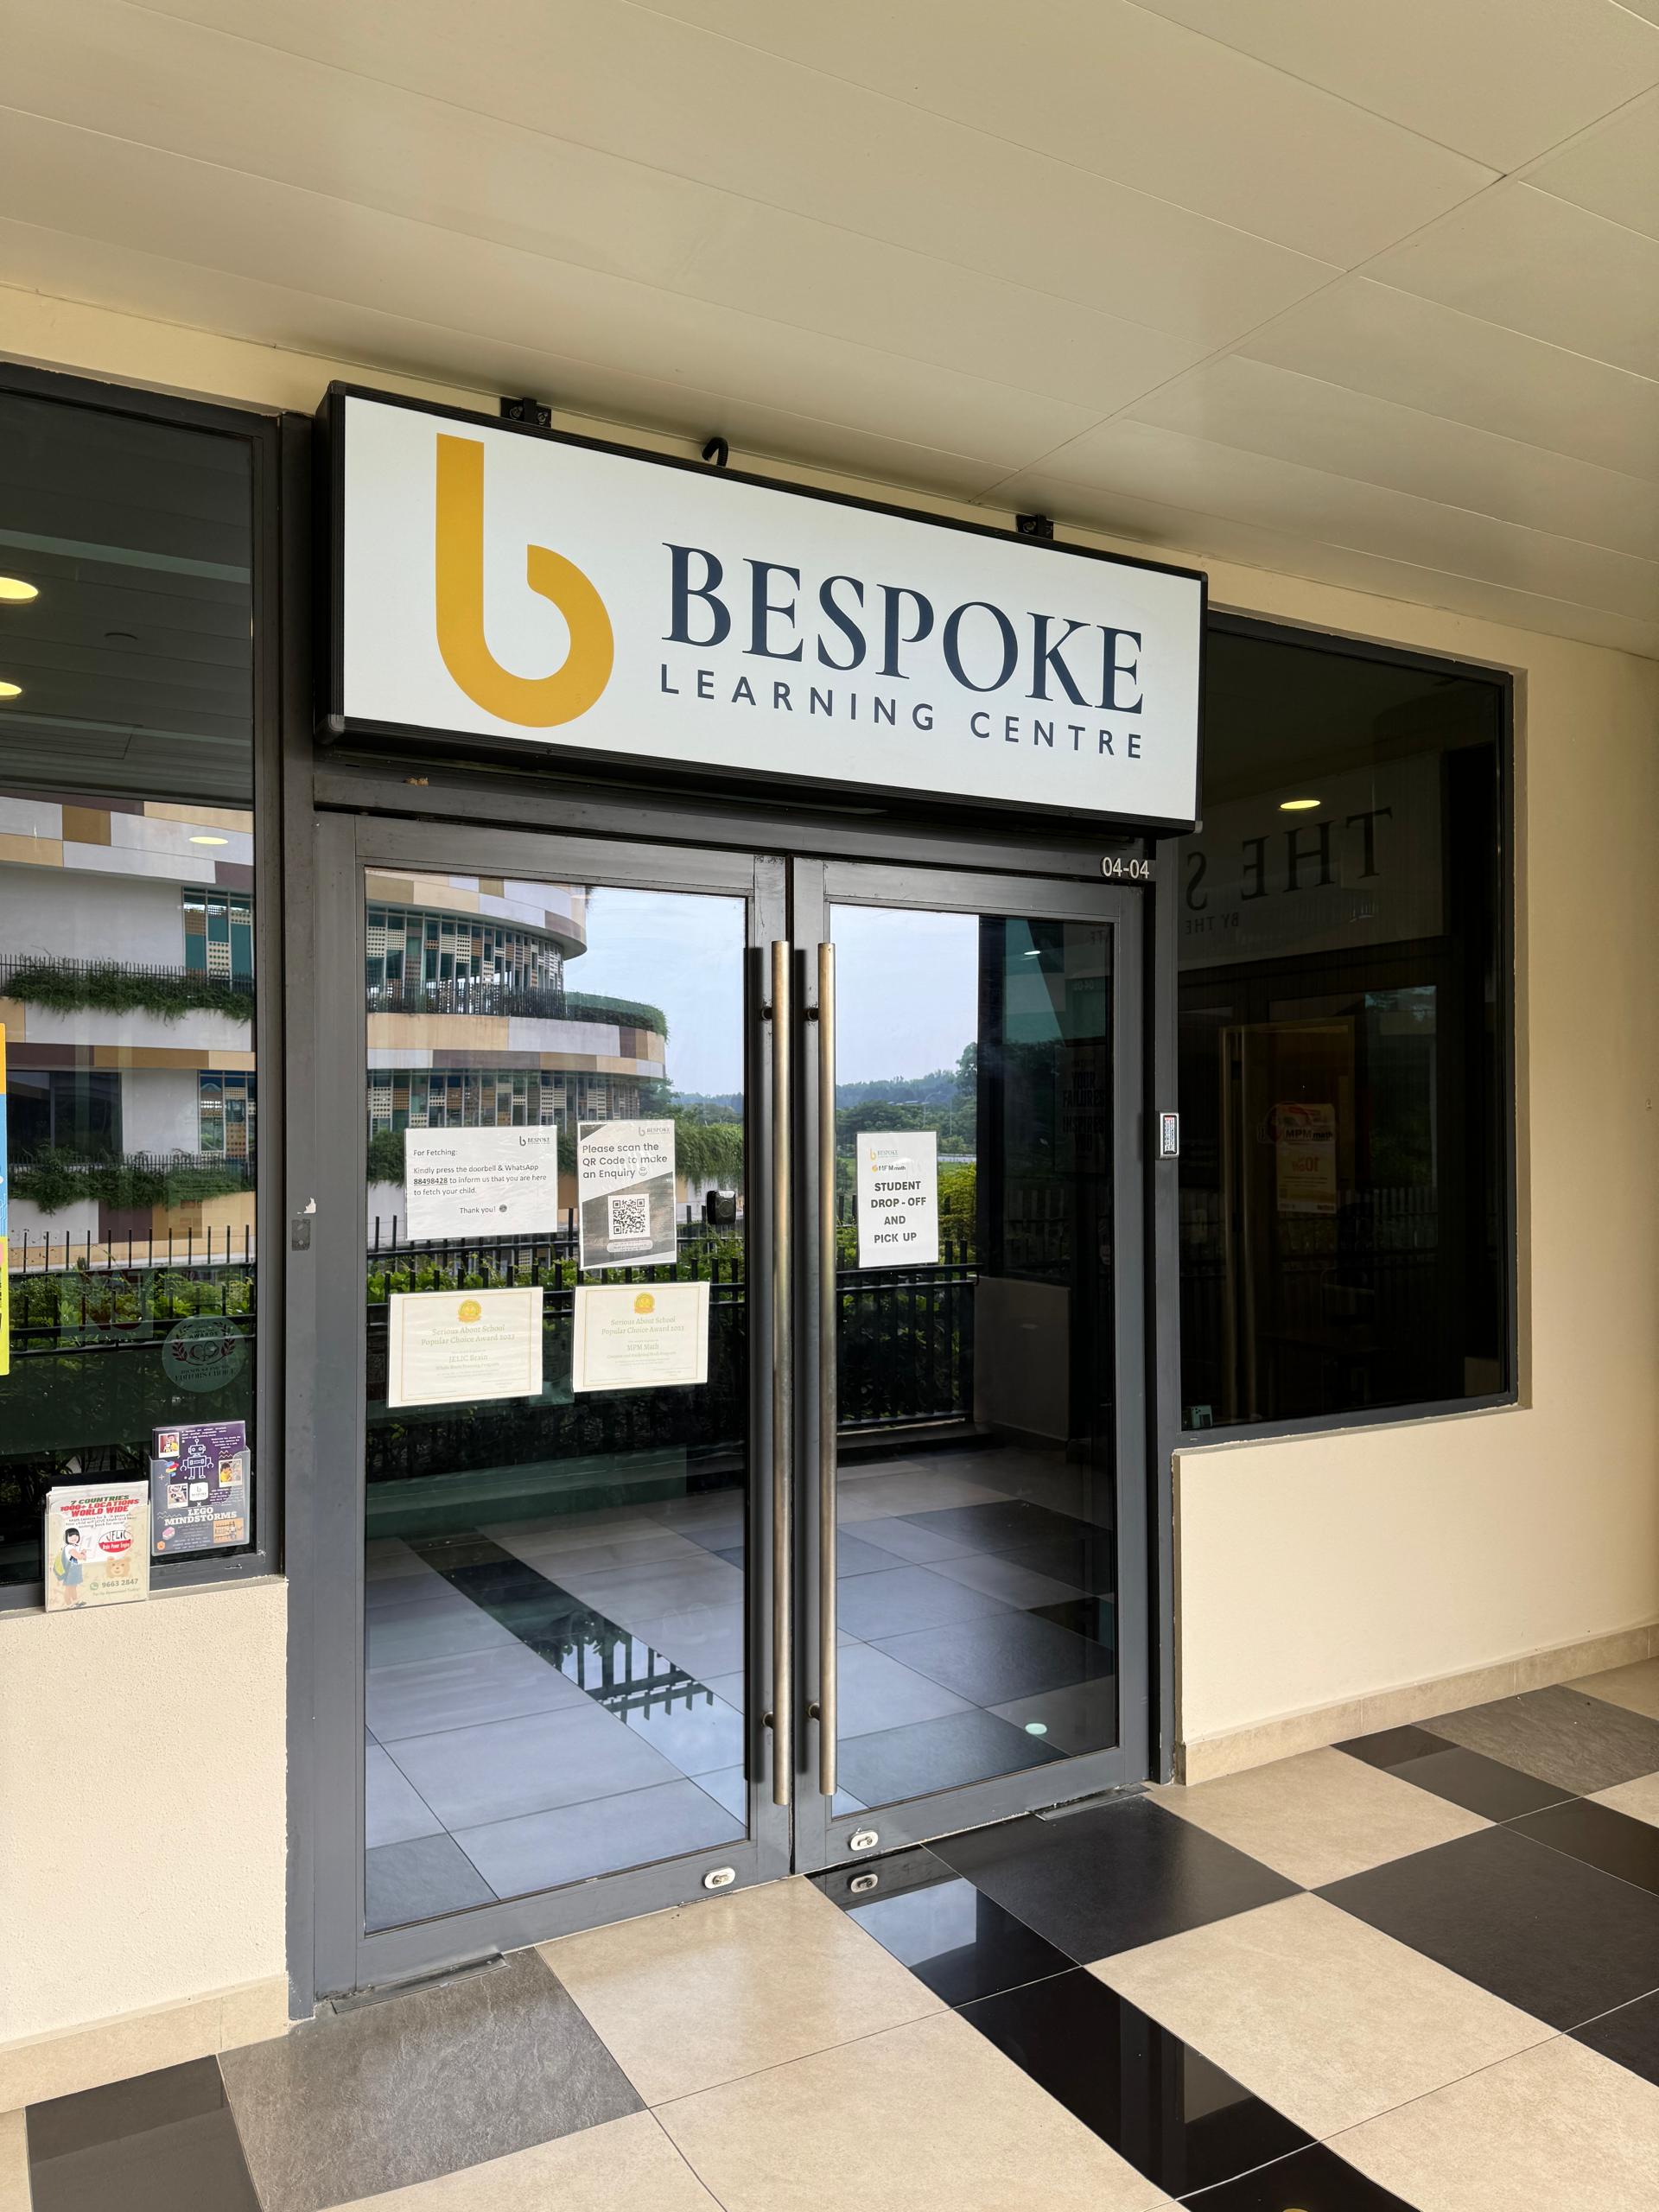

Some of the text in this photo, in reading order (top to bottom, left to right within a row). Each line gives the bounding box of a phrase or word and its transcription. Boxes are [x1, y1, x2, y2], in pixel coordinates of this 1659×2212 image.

[662, 542, 1143, 715] BESPOKE
[661, 663, 1141, 759] LEARNING CENTRE
[1102, 856, 1149, 879] 04-04
[583, 1158, 595, 1166] QR
[600, 1156, 625, 1165] Code
[600, 1168, 635, 1179] Enquiry
[874, 1181, 921, 1192] STUDENT
[871, 1198, 899, 1208] DROP
[908, 1198, 926, 1206] OFF
[884, 1216, 906, 1225] AND
[874, 1232, 917, 1243] PICK UP
[432, 1327, 459, 1336] Serious
[421, 1338, 448, 1346] Popular
[79, 1495, 130, 1503] COUNTRIES
[88, 1499, 140, 1509] LOCATIONS
[72, 1509, 103, 1517] WORLD
[106, 1505, 129, 1514] WIDE
[188, 1507, 213, 1516] LEGO
[164, 1511, 237, 1526] MINDSTORMS
